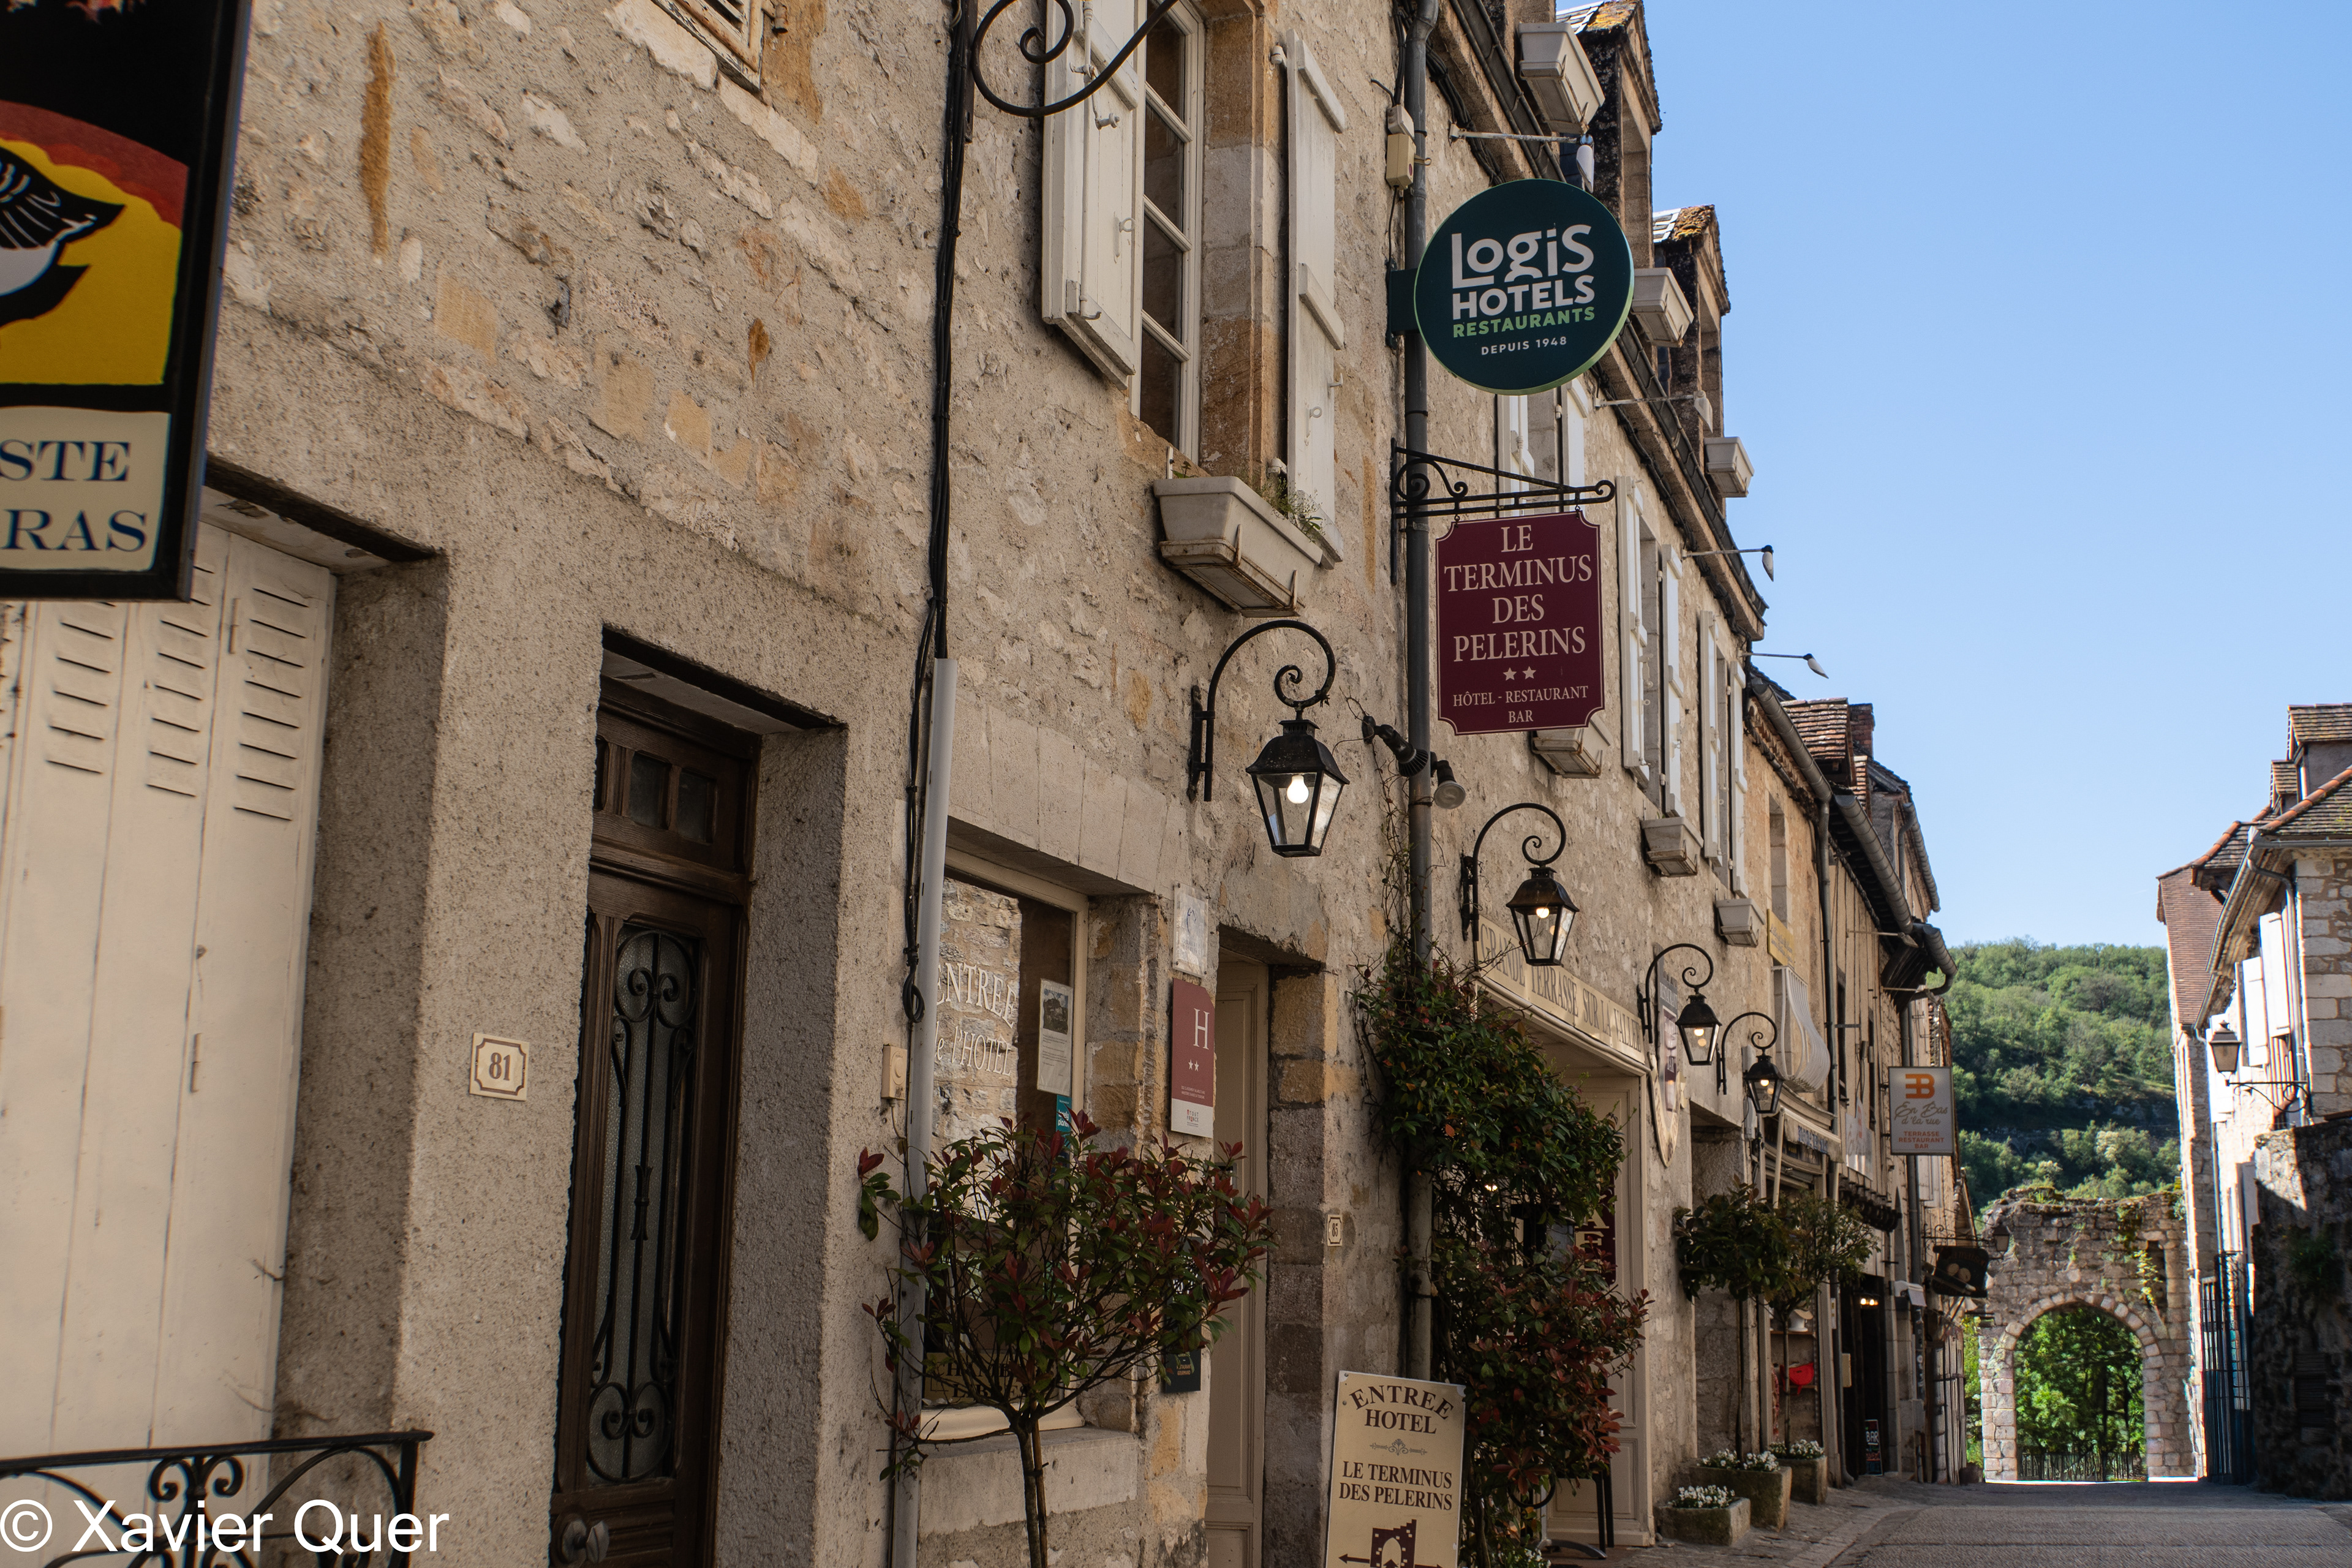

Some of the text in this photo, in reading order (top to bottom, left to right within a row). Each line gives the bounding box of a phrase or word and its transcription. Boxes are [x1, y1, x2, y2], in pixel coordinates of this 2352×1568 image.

[1452, 275, 1596, 320] HOTELS
[1453, 306, 1596, 337] RESTAURANTS
[1481, 336, 1567, 355] DEPUIS 1948
[1501, 525, 1534, 552] LE
[1444, 554, 1592, 592] TERMINUS
[1492, 594, 1545, 624] DES
[1453, 626, 1586, 662] PELERINS
[1453, 690, 1496, 707] HÔTEL
[1505, 685, 1589, 704] RESTAURANT
[1508, 710, 1534, 723] BAR
[1480, 923, 1526, 987] GRANDE
[1531, 966, 1578, 1017] TERRASSE
[1583, 988, 1599, 1030] SUR
[1600, 1000, 1611, 1037] LA
[1193, 1008, 1210, 1050] H
[489, 1052, 511, 1080] 81
[1894, 1101, 1948, 1120] En Bas
[1332, 1223, 1338, 1237] 85
[1349, 1385, 1454, 1420] ENTREE
[1365, 1409, 1437, 1434] HOTEL
[1866, 1431, 1879, 1442] BAR
[1342, 1461, 1452, 1489] LE TERMINUS
[1339, 1482, 1452, 1511] DES PELERINS
